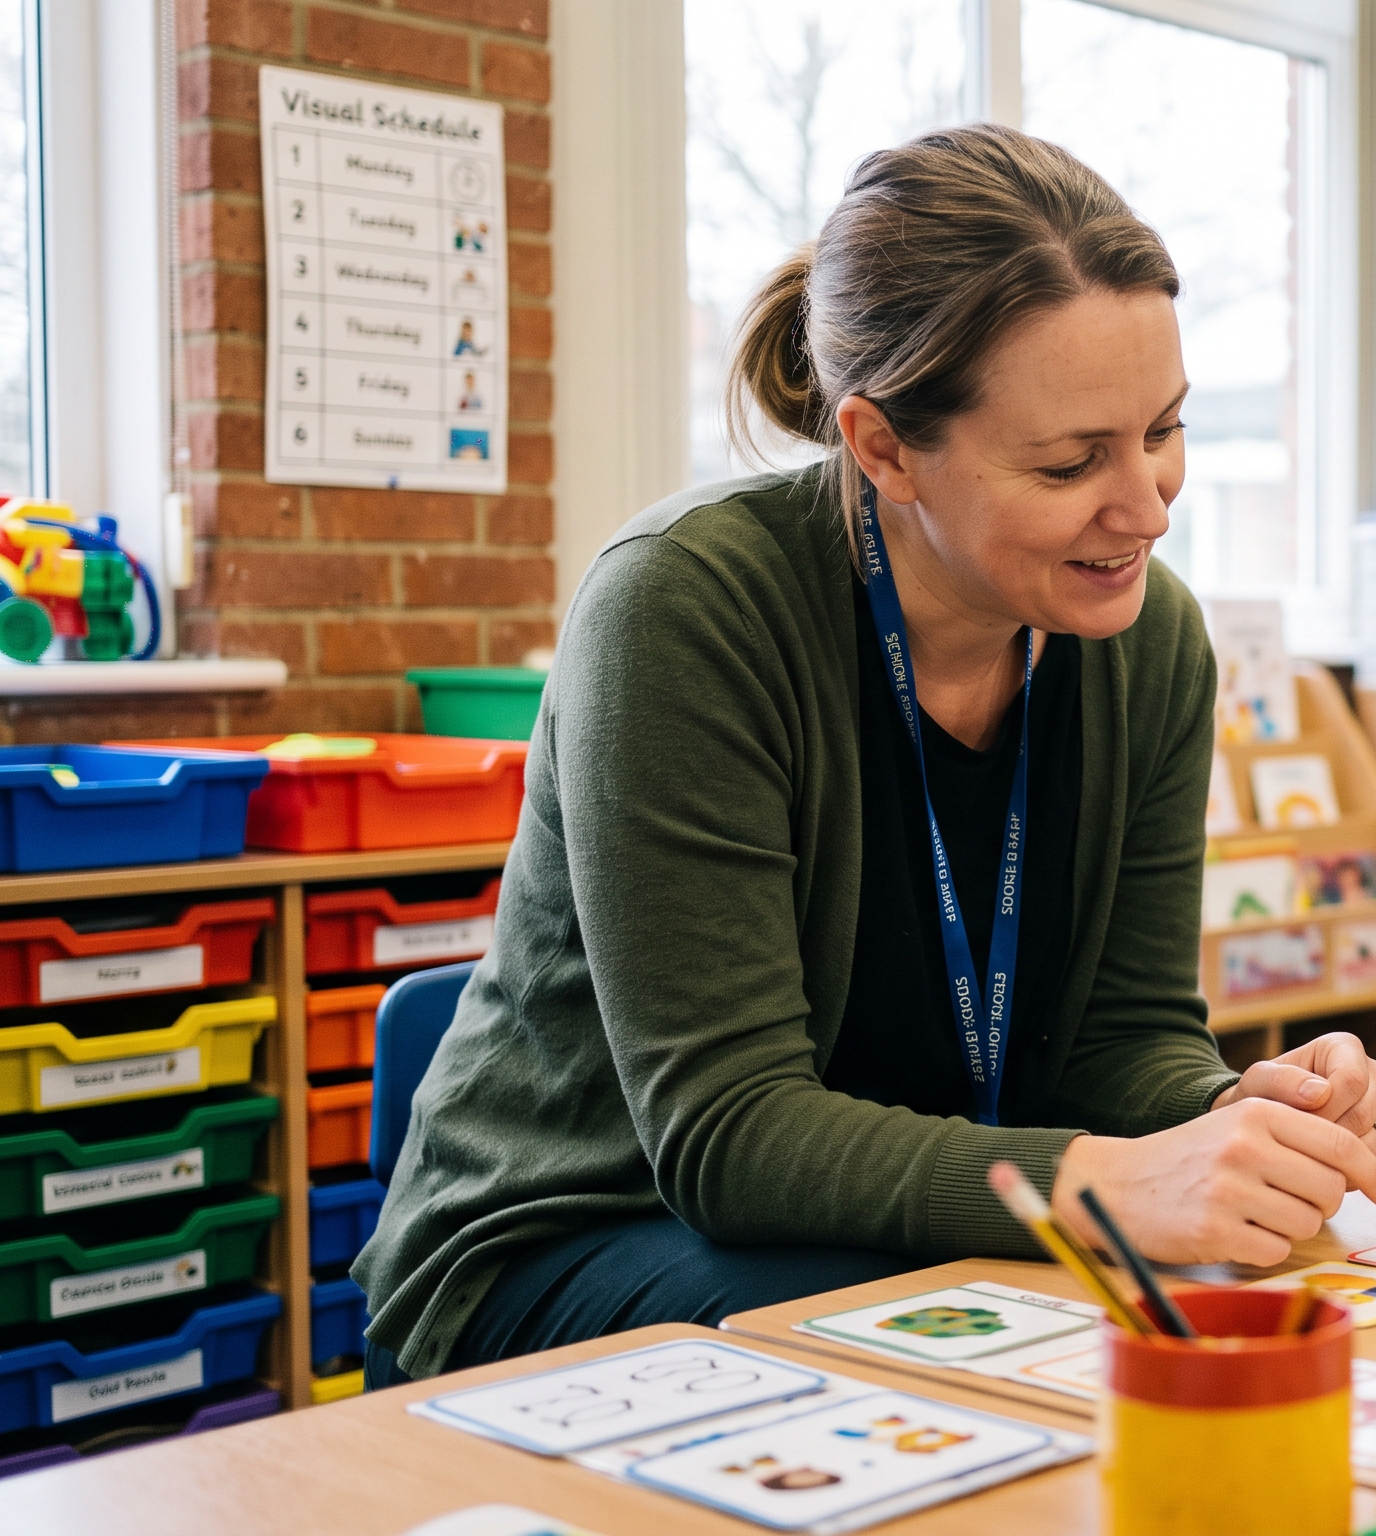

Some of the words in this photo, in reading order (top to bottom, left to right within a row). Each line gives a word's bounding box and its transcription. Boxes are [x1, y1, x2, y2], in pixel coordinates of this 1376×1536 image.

[281, 87, 364, 125] Visual
[372, 101, 481, 142] Schedule
[291, 143, 301, 168] 1
[345, 153, 414, 186] Monday
[292, 199, 306, 223] 2
[348, 207, 416, 238] Tuesday
[293, 254, 308, 279] 3
[335, 261, 429, 295] Wednesday
[294, 311, 309, 335] 4
[345, 316, 421, 348] Thursday
[294, 366, 308, 391] 5
[357, 372, 411, 400] Friday
[293, 421, 307, 445] 6
